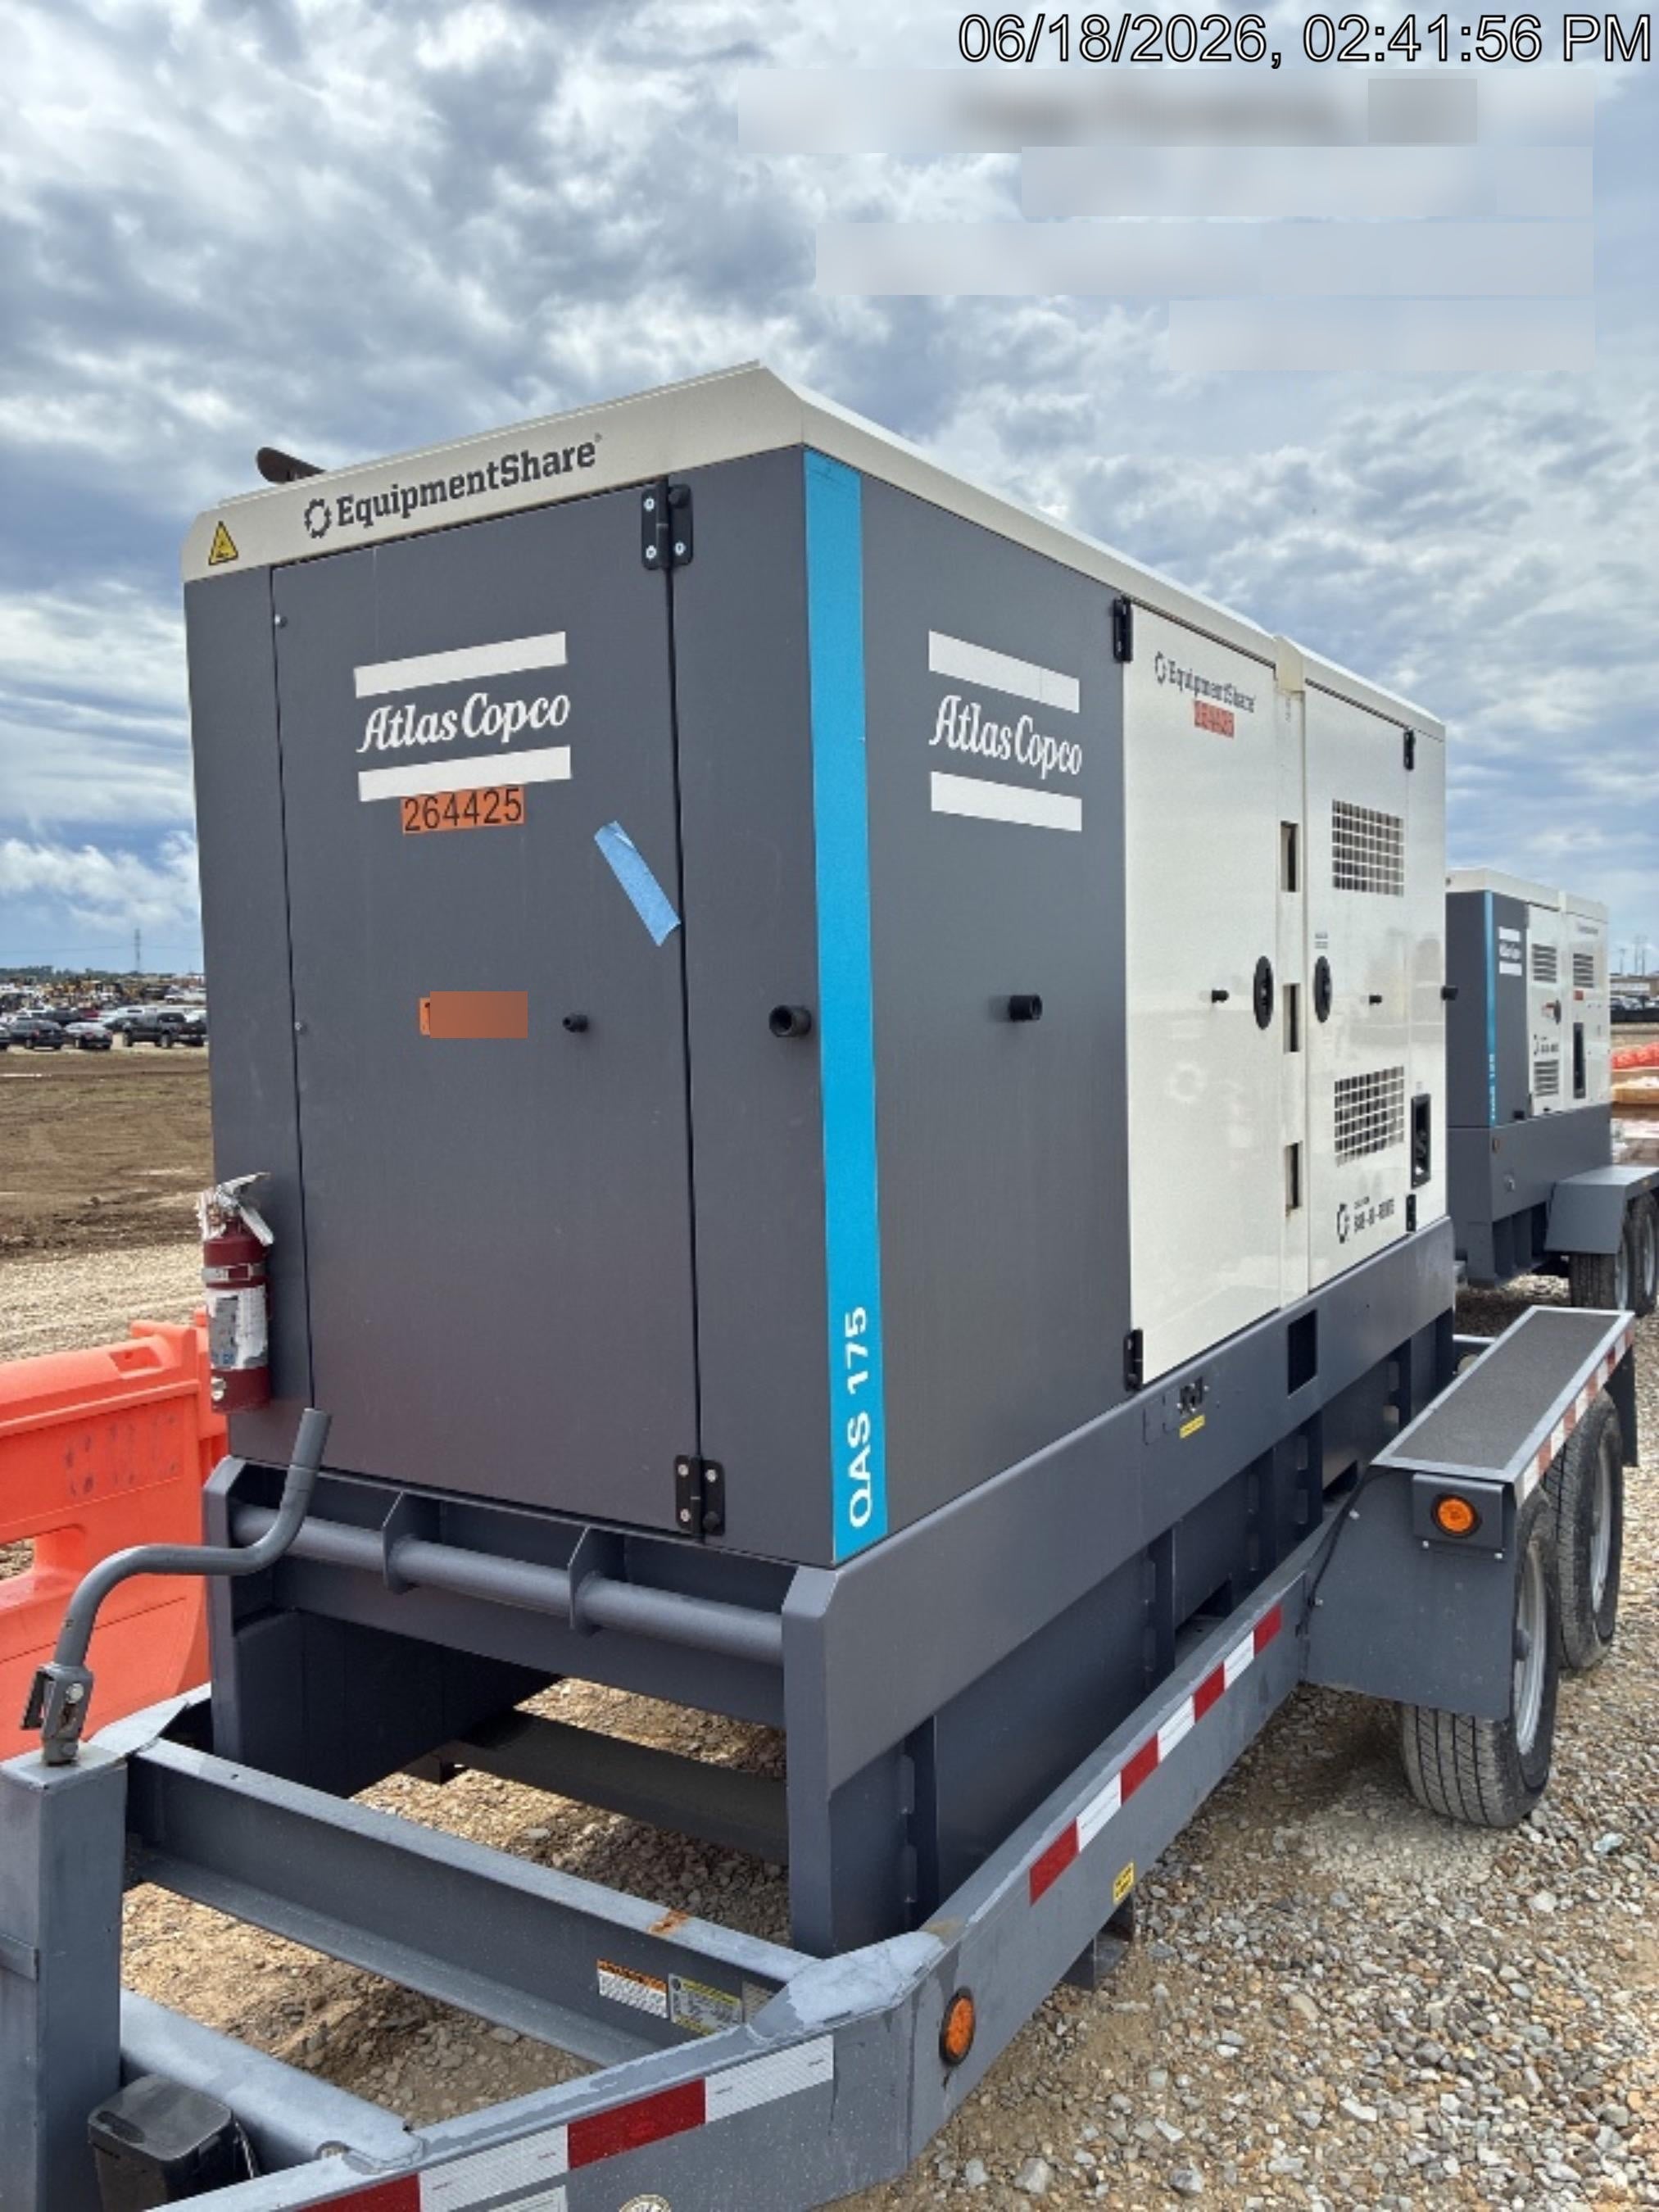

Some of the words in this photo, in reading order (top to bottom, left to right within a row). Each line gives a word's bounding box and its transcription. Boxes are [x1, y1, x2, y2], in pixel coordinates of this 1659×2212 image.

[336, 442, 596, 528] EquipmentShare
[404, 786, 523, 832] 264425
[844, 1306, 869, 1394] 175
[846, 1410, 873, 1528] QAS
